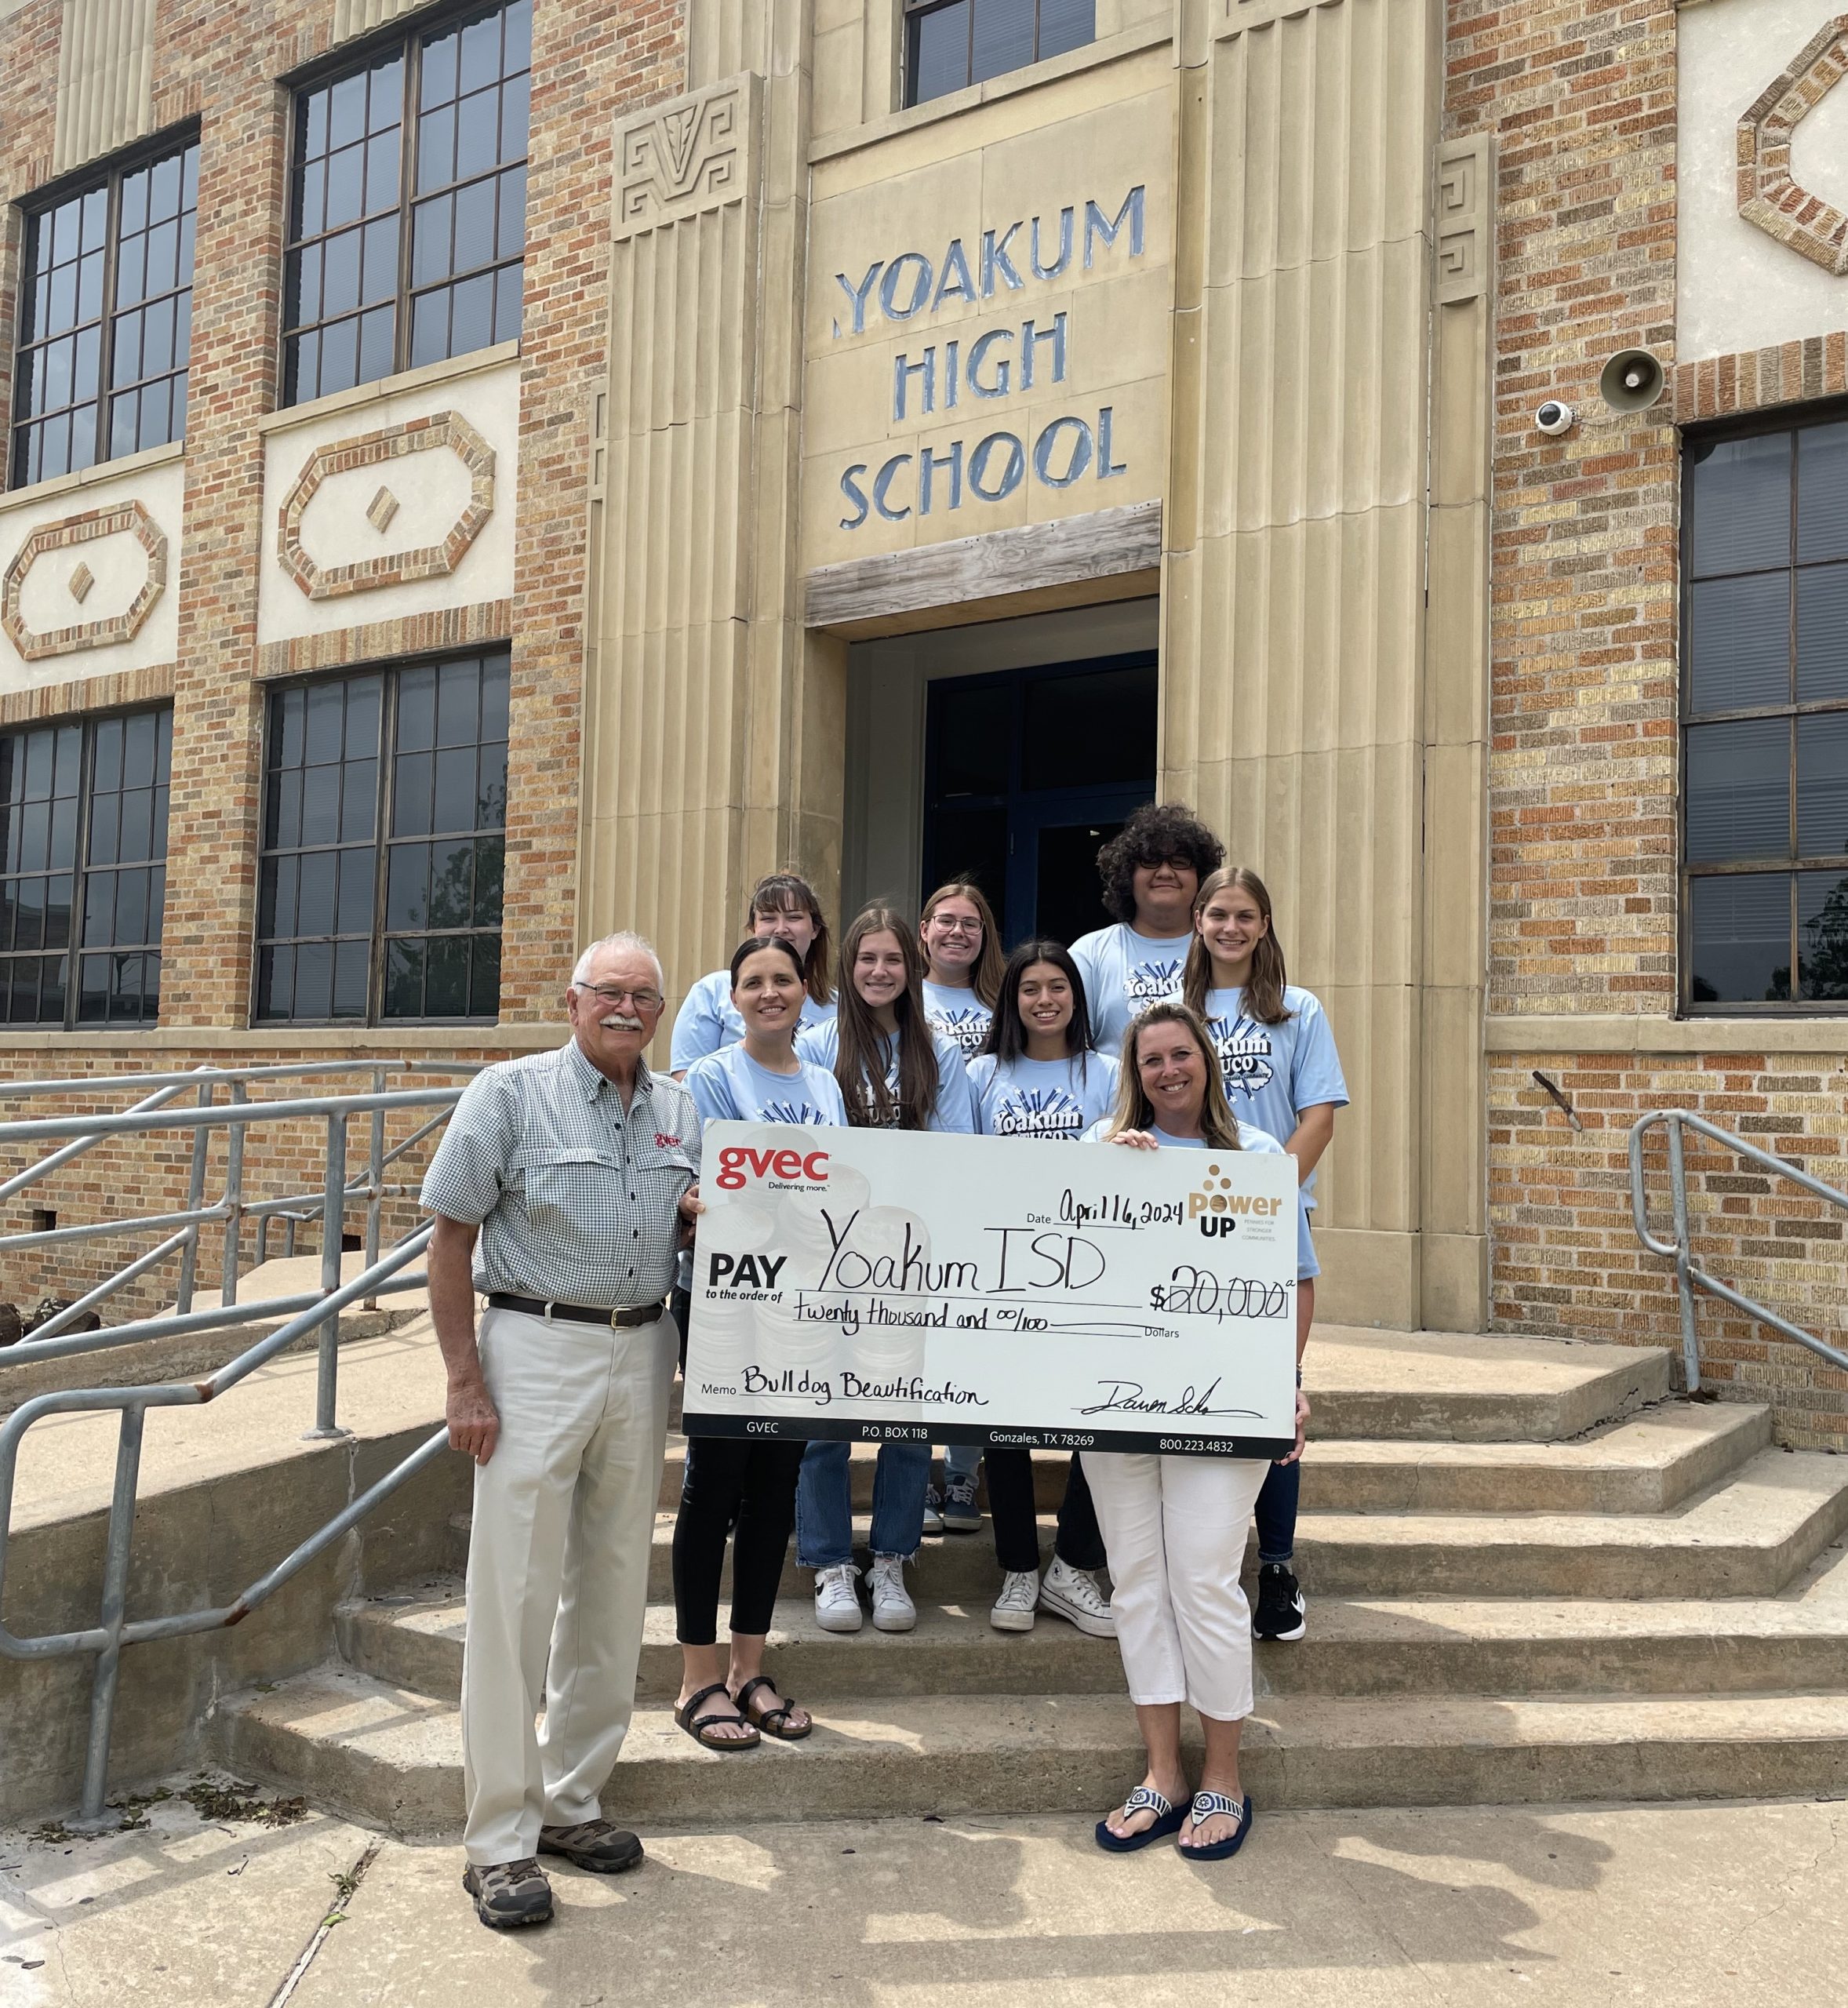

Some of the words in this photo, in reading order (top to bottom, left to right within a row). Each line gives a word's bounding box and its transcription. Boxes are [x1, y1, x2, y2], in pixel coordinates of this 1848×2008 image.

[834, 184, 1145, 337] YOAKUM
[893, 311, 1068, 422] HIGH
[839, 406, 1127, 530] SCHOOL
[1123, 977, 1184, 997] Yoaku
[993, 1110, 1080, 1134] Yoakum
[715, 1147, 829, 1190] gvec
[768, 1181, 805, 1193] Delivering
[1027, 1213, 1051, 1224] Date
[1059, 1188, 1107, 1229] April
[1140, 1201, 1183, 1225] 2024
[1200, 1215, 1236, 1239] UP
[818, 1207, 980, 1293] Yoakum
[984, 1227, 1107, 1294] ISD
[708, 1252, 788, 1290] PAY
[706, 1289, 717, 1299] to
[719, 1289, 737, 1300] the
[739, 1290, 769, 1301] order
[770, 1291, 784, 1304] of
[866, 1297, 948, 1328] thousand
[956, 1306, 988, 1330] and
[1144, 1326, 1180, 1338] Dollars
[701, 1384, 737, 1396] Memo
[741, 1365, 831, 1406] Bulldog
[839, 1371, 989, 1406] Beautification
[746, 1421, 779, 1434] GVEC
[861, 1425, 882, 1439] P.O.
[885, 1426, 909, 1439] BOX
[911, 1428, 928, 1439] 118
[988, 1430, 1040, 1446] Gonzales,
[1042, 1433, 1058, 1445] TX
[1060, 1434, 1094, 1446] 78269
[1159, 1439, 1235, 1453] 800.223.4832
